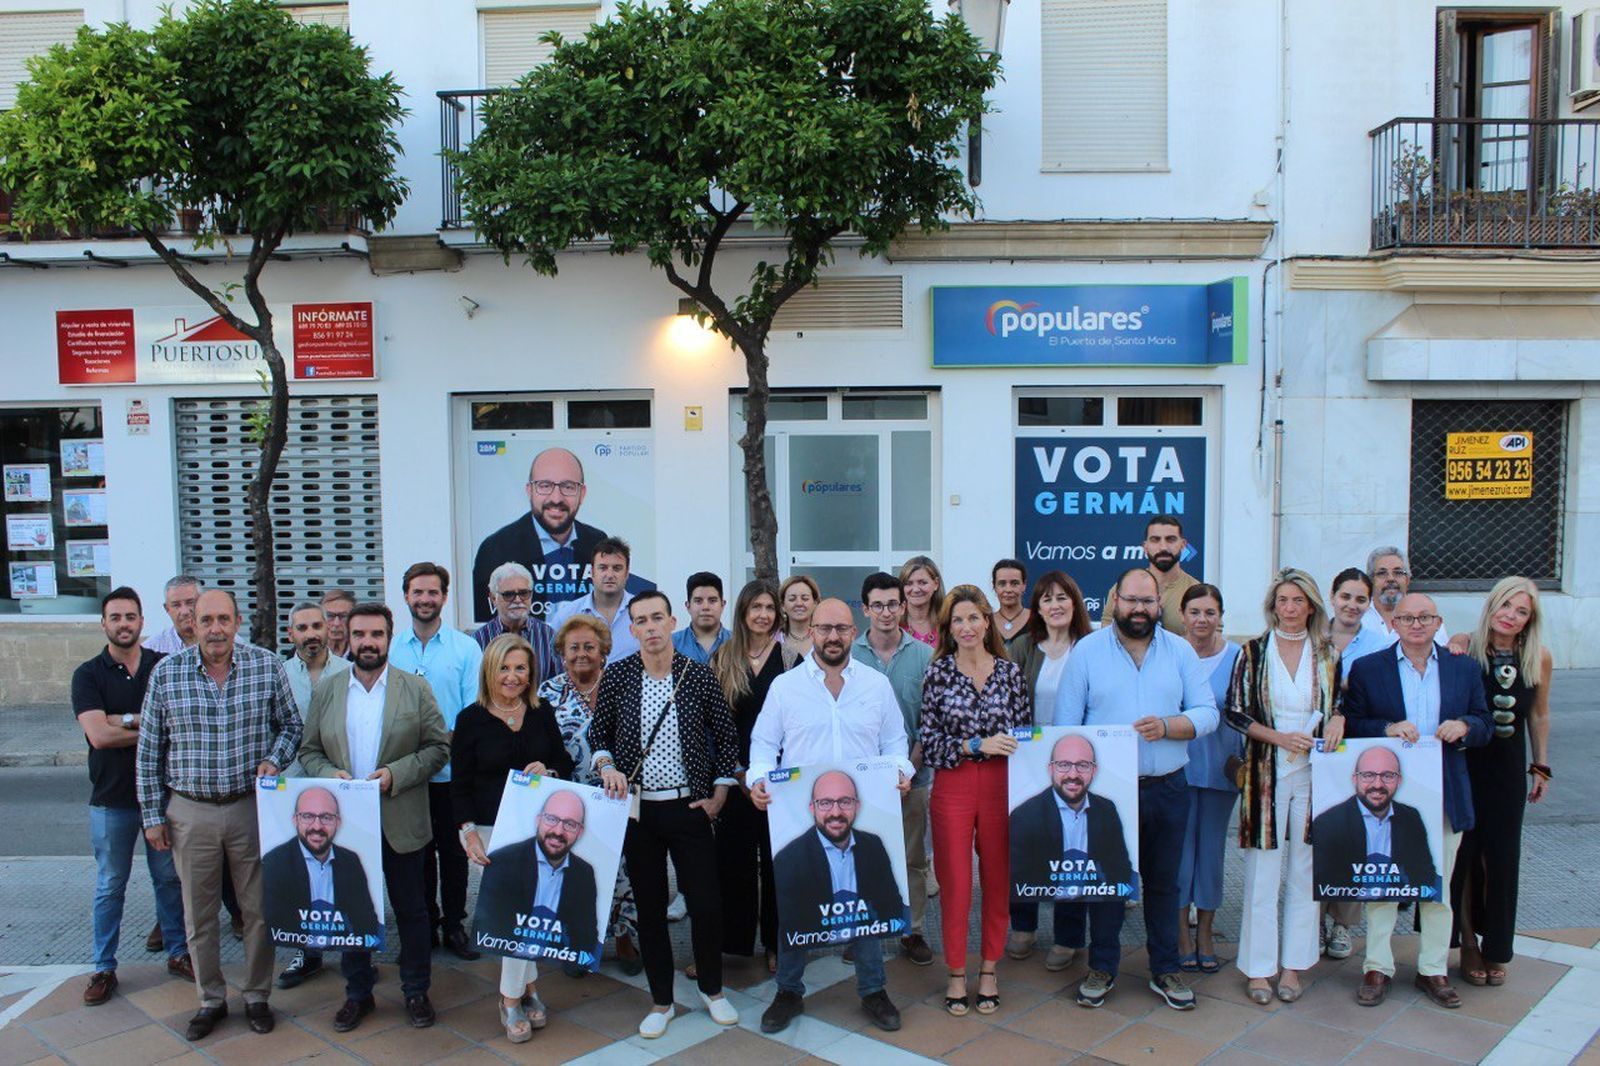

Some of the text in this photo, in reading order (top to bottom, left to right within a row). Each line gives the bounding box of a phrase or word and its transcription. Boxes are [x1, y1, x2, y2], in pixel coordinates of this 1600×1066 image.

[298, 308, 368, 322] INFÓRMATE
[1002, 305, 1142, 338] populares
[1060, 336, 1096, 346] Puerto
[1098, 336, 1112, 346] de
[1114, 336, 1146, 346] Santa
[152, 344, 265, 362] PUERTOSU
[1033, 446, 1185, 484] VOTA
[1450, 460, 1530, 480] 956 54 23 23
[808, 482, 862, 494] populares
[1034, 486, 1185, 515] GERMÁN
[1026, 540, 1096, 560] Vamos
[1101, 547, 1116, 560] a
[532, 564, 593, 580] VOTA
[1050, 859, 1097, 872] VOTA
[1352, 863, 1400, 874] VOTA
[1050, 872, 1097, 881] GERMÁN
[1353, 874, 1400, 883] GERMÁN
[1016, 882, 1116, 897] Vamos a más
[1319, 884, 1419, 897] Vamos a más
[299, 908, 344, 922] VOTA
[819, 899, 868, 916] VOTA
[300, 922, 345, 932] GERMÁN
[516, 913, 562, 933] VOTA
[822, 912, 870, 926] GERMÁN
[271, 927, 363, 946] Vamos a más
[513, 927, 562, 943] GERMÁN
[787, 920, 888, 946] Vamos a más
[476, 931, 577, 962] Vamos a más
